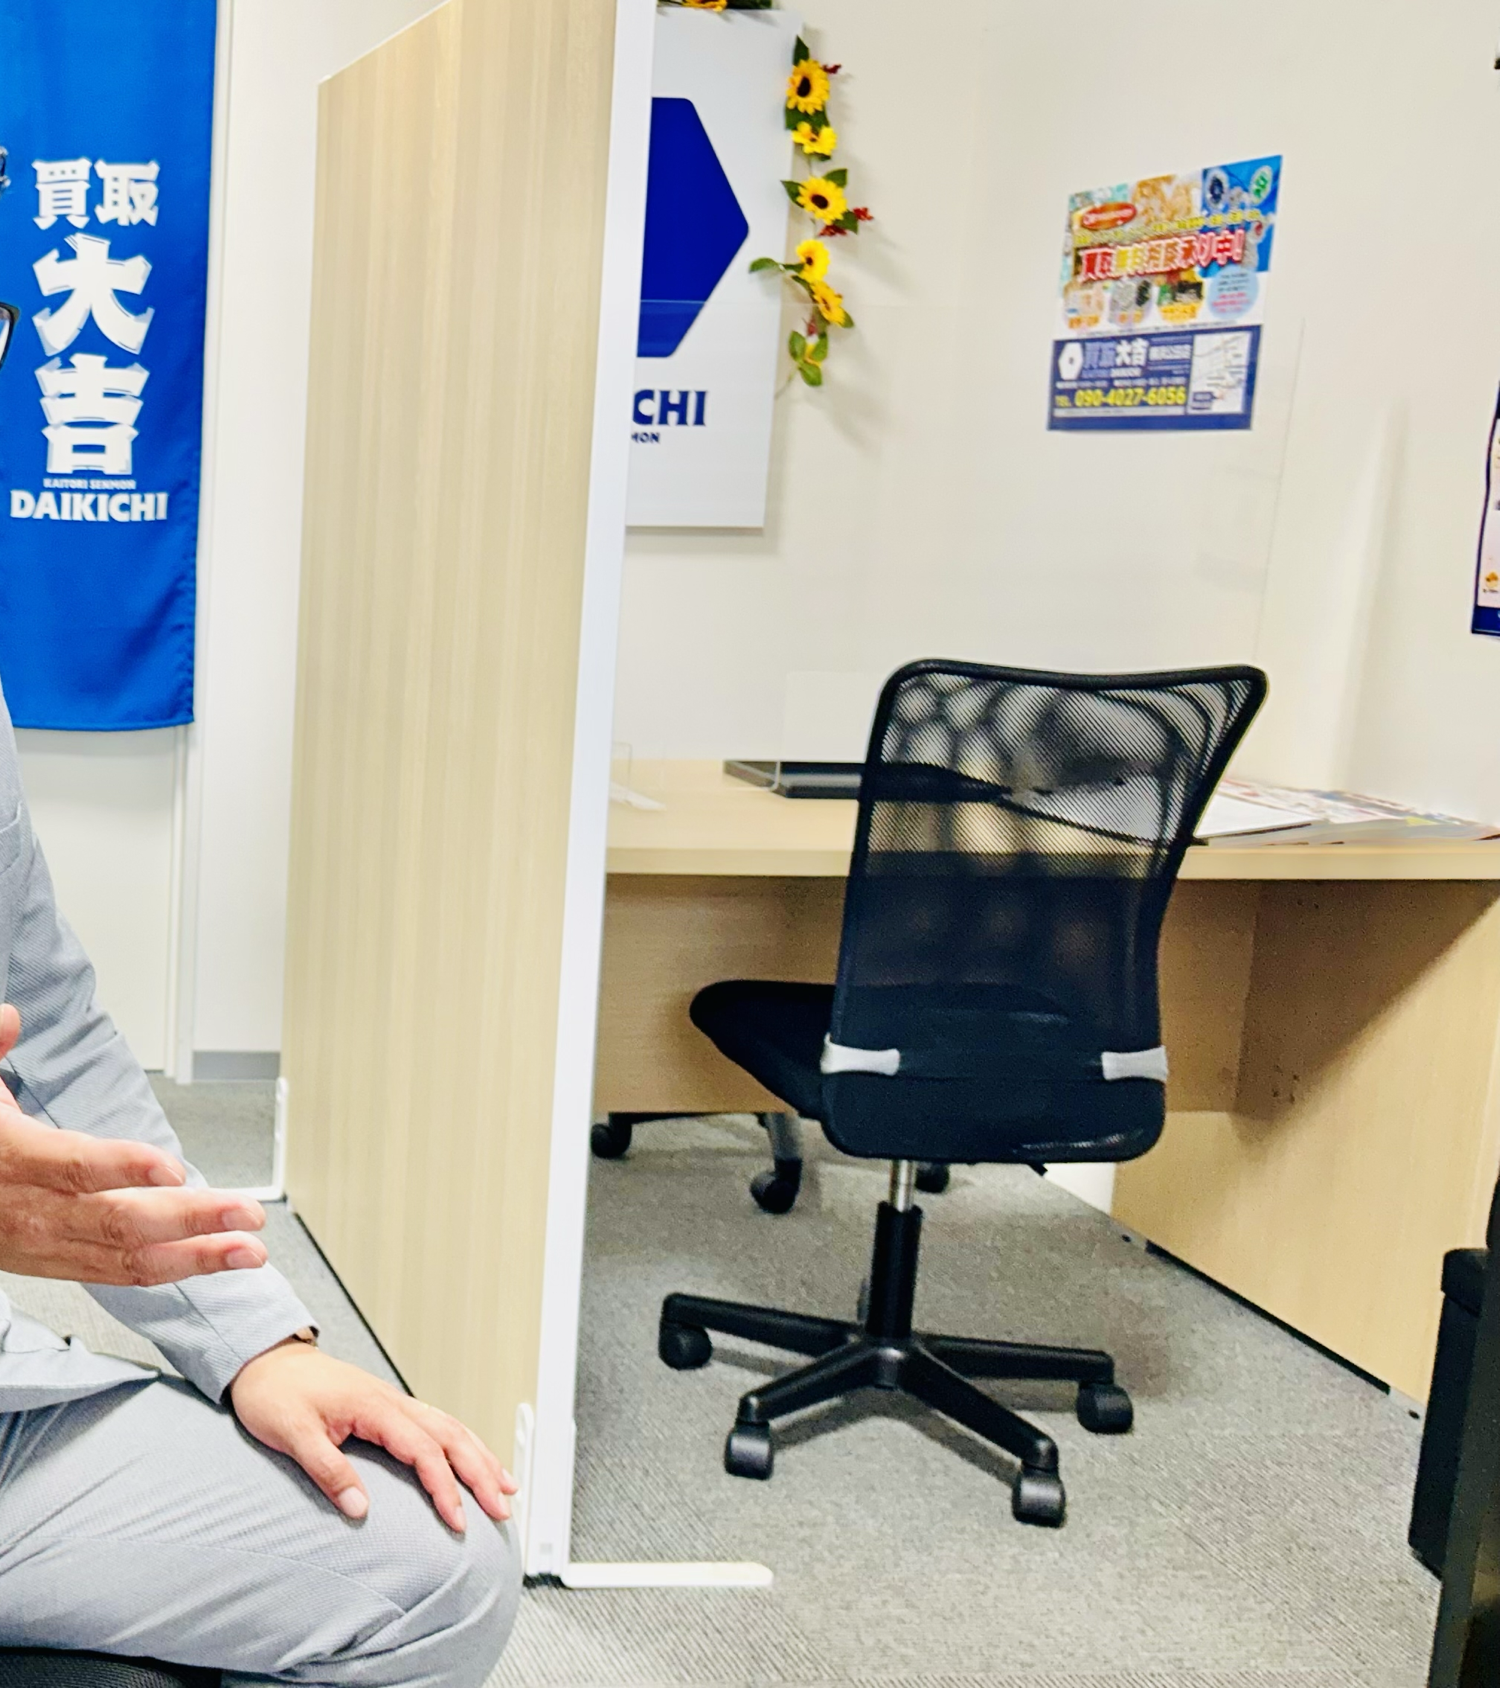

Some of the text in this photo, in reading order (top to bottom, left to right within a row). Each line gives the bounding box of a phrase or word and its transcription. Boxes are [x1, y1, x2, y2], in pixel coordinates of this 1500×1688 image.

[31, 157, 161, 230] 買取
[31, 232, 155, 475] 大吉
[632, 389, 706, 426] CHI
[1074, 385, 1187, 408] 090-4027-6056
[10, 489, 169, 523] DAIKICHI
